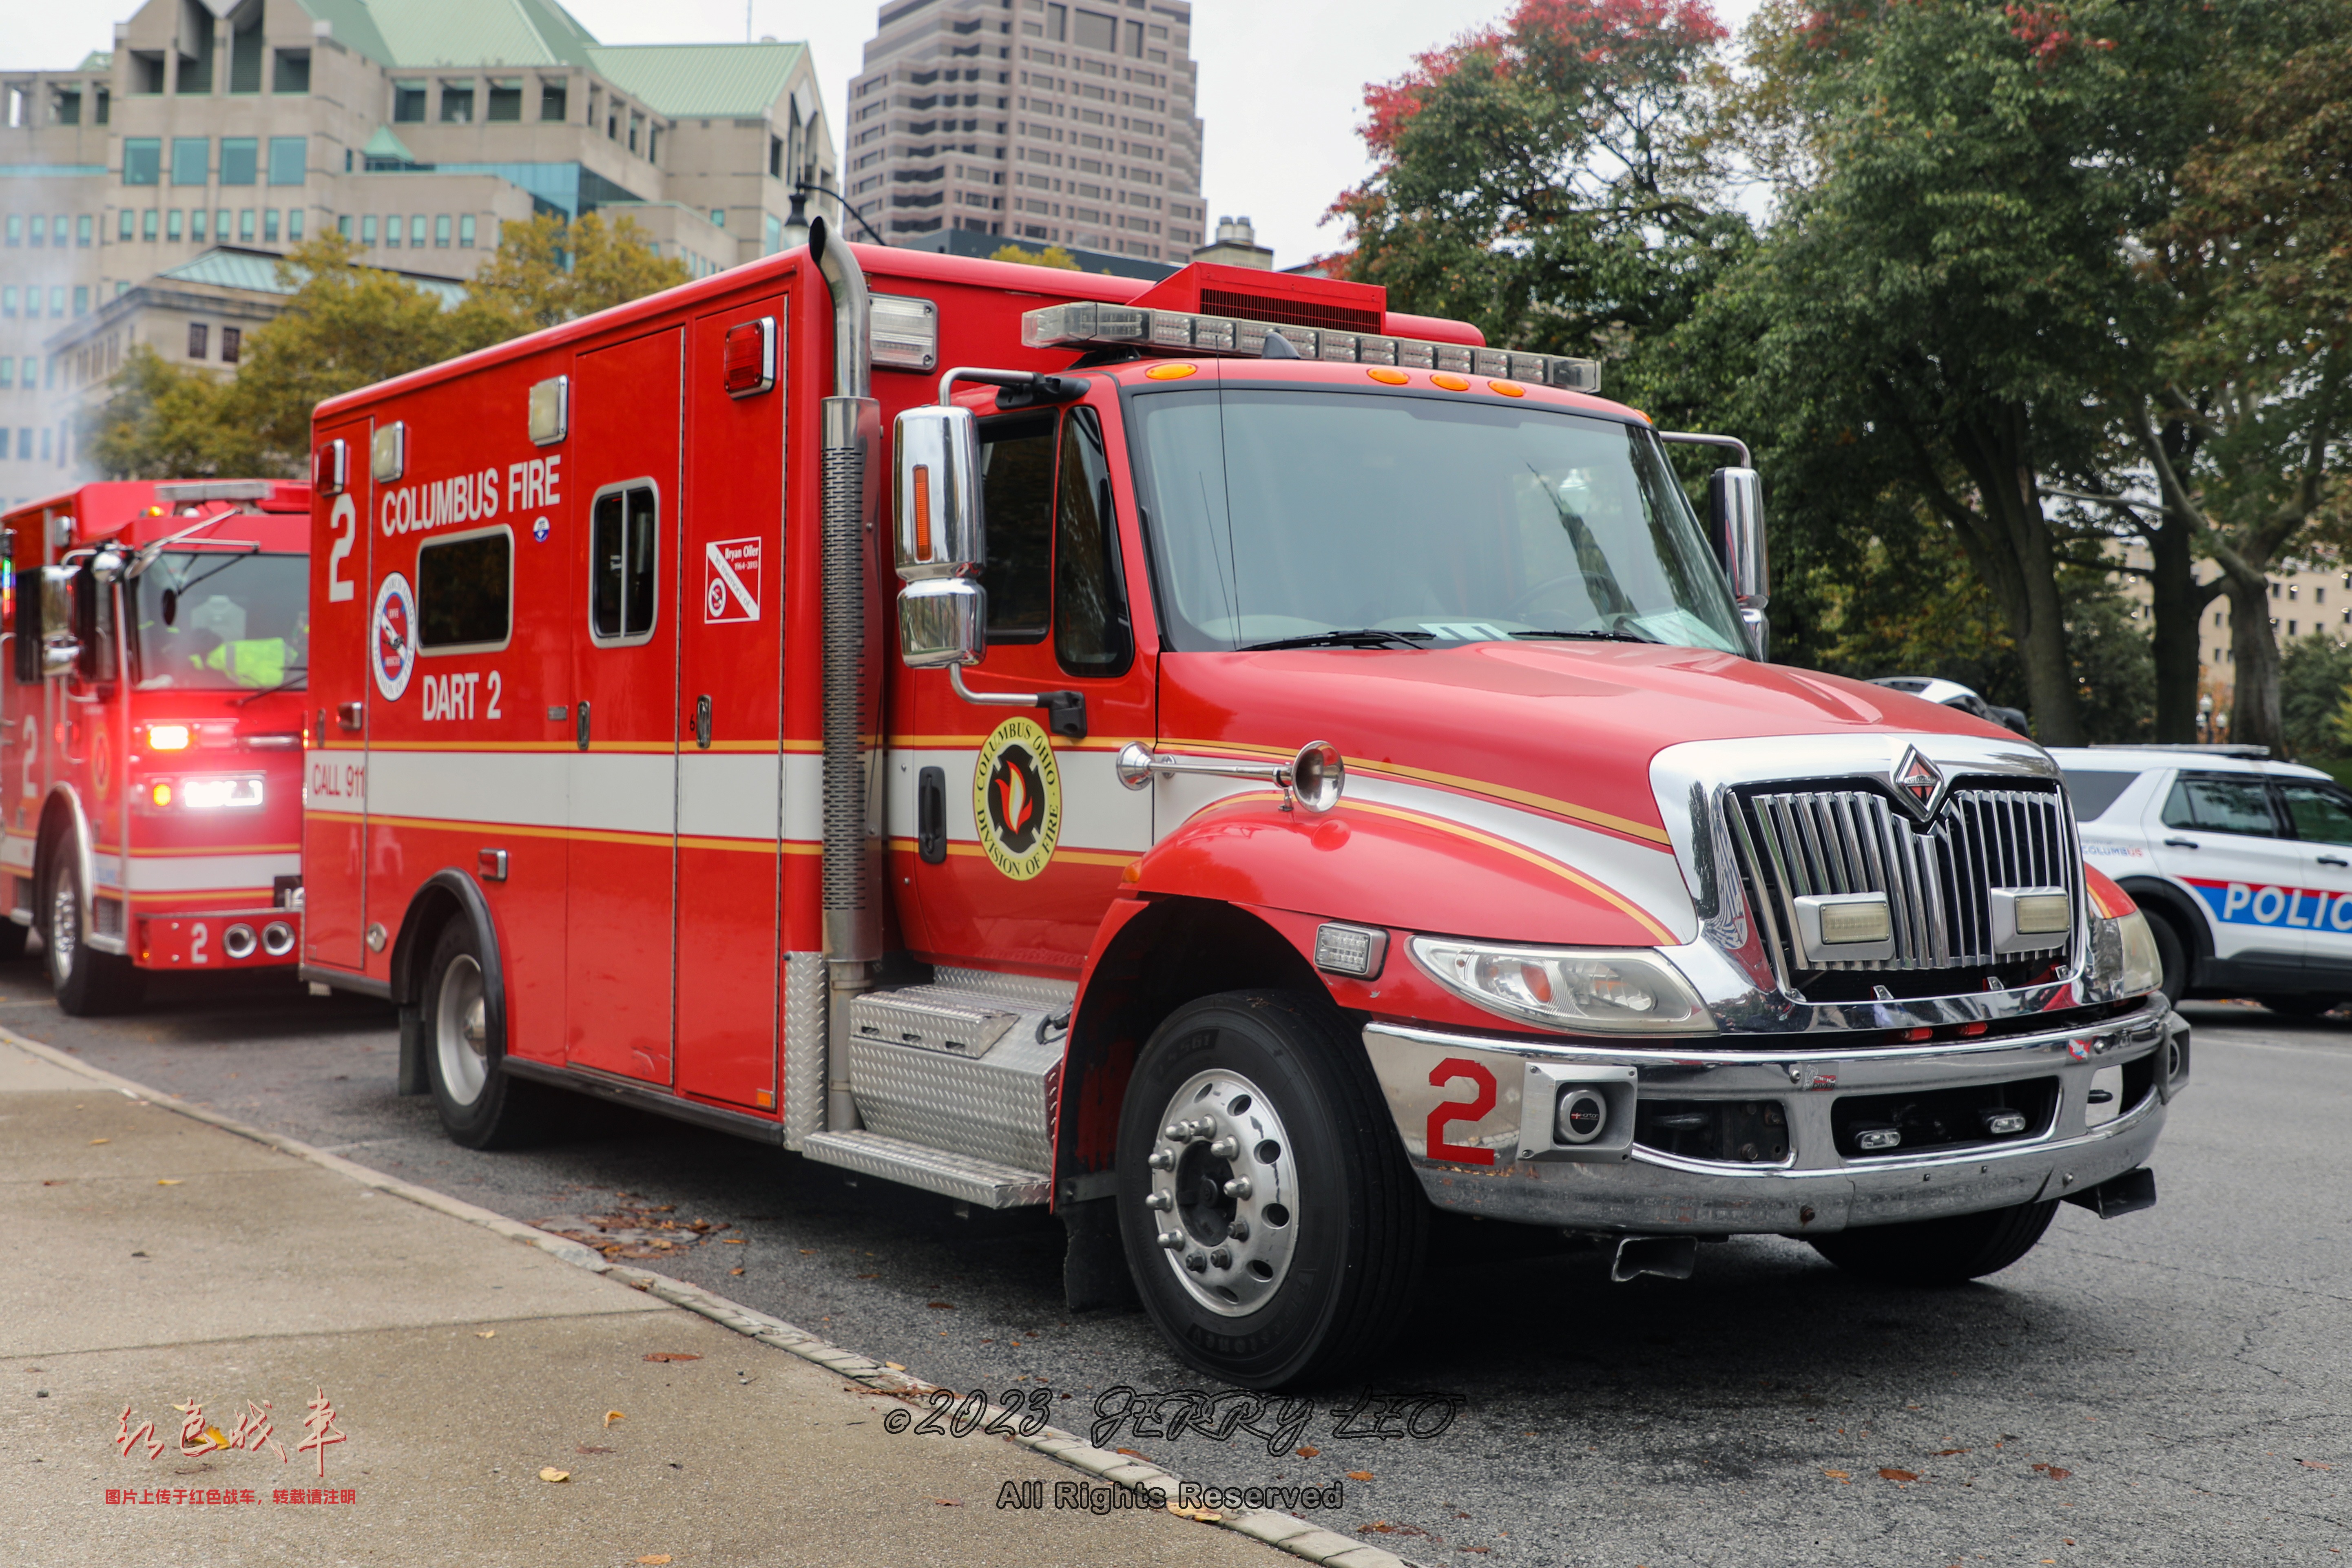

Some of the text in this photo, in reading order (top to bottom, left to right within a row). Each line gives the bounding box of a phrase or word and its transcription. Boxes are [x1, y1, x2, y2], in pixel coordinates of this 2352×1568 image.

[382, 454, 561, 537] COLUMBUS FIRE
[329, 493, 356, 603] 2
[725, 548, 742, 562] Bryan
[715, 554, 751, 608] In memory of
[423, 670, 502, 721] DART 2
[22, 714, 38, 797] 2
[312, 764, 365, 798] CALL 911
[976, 722, 1055, 791] COLUMBUS OHIO
[976, 804, 1058, 876] DIVISION OF FIRE
[2081, 844, 2143, 857] COLUMBUS
[190, 922, 208, 963] 2
[1427, 1057, 1497, 1165] 2
